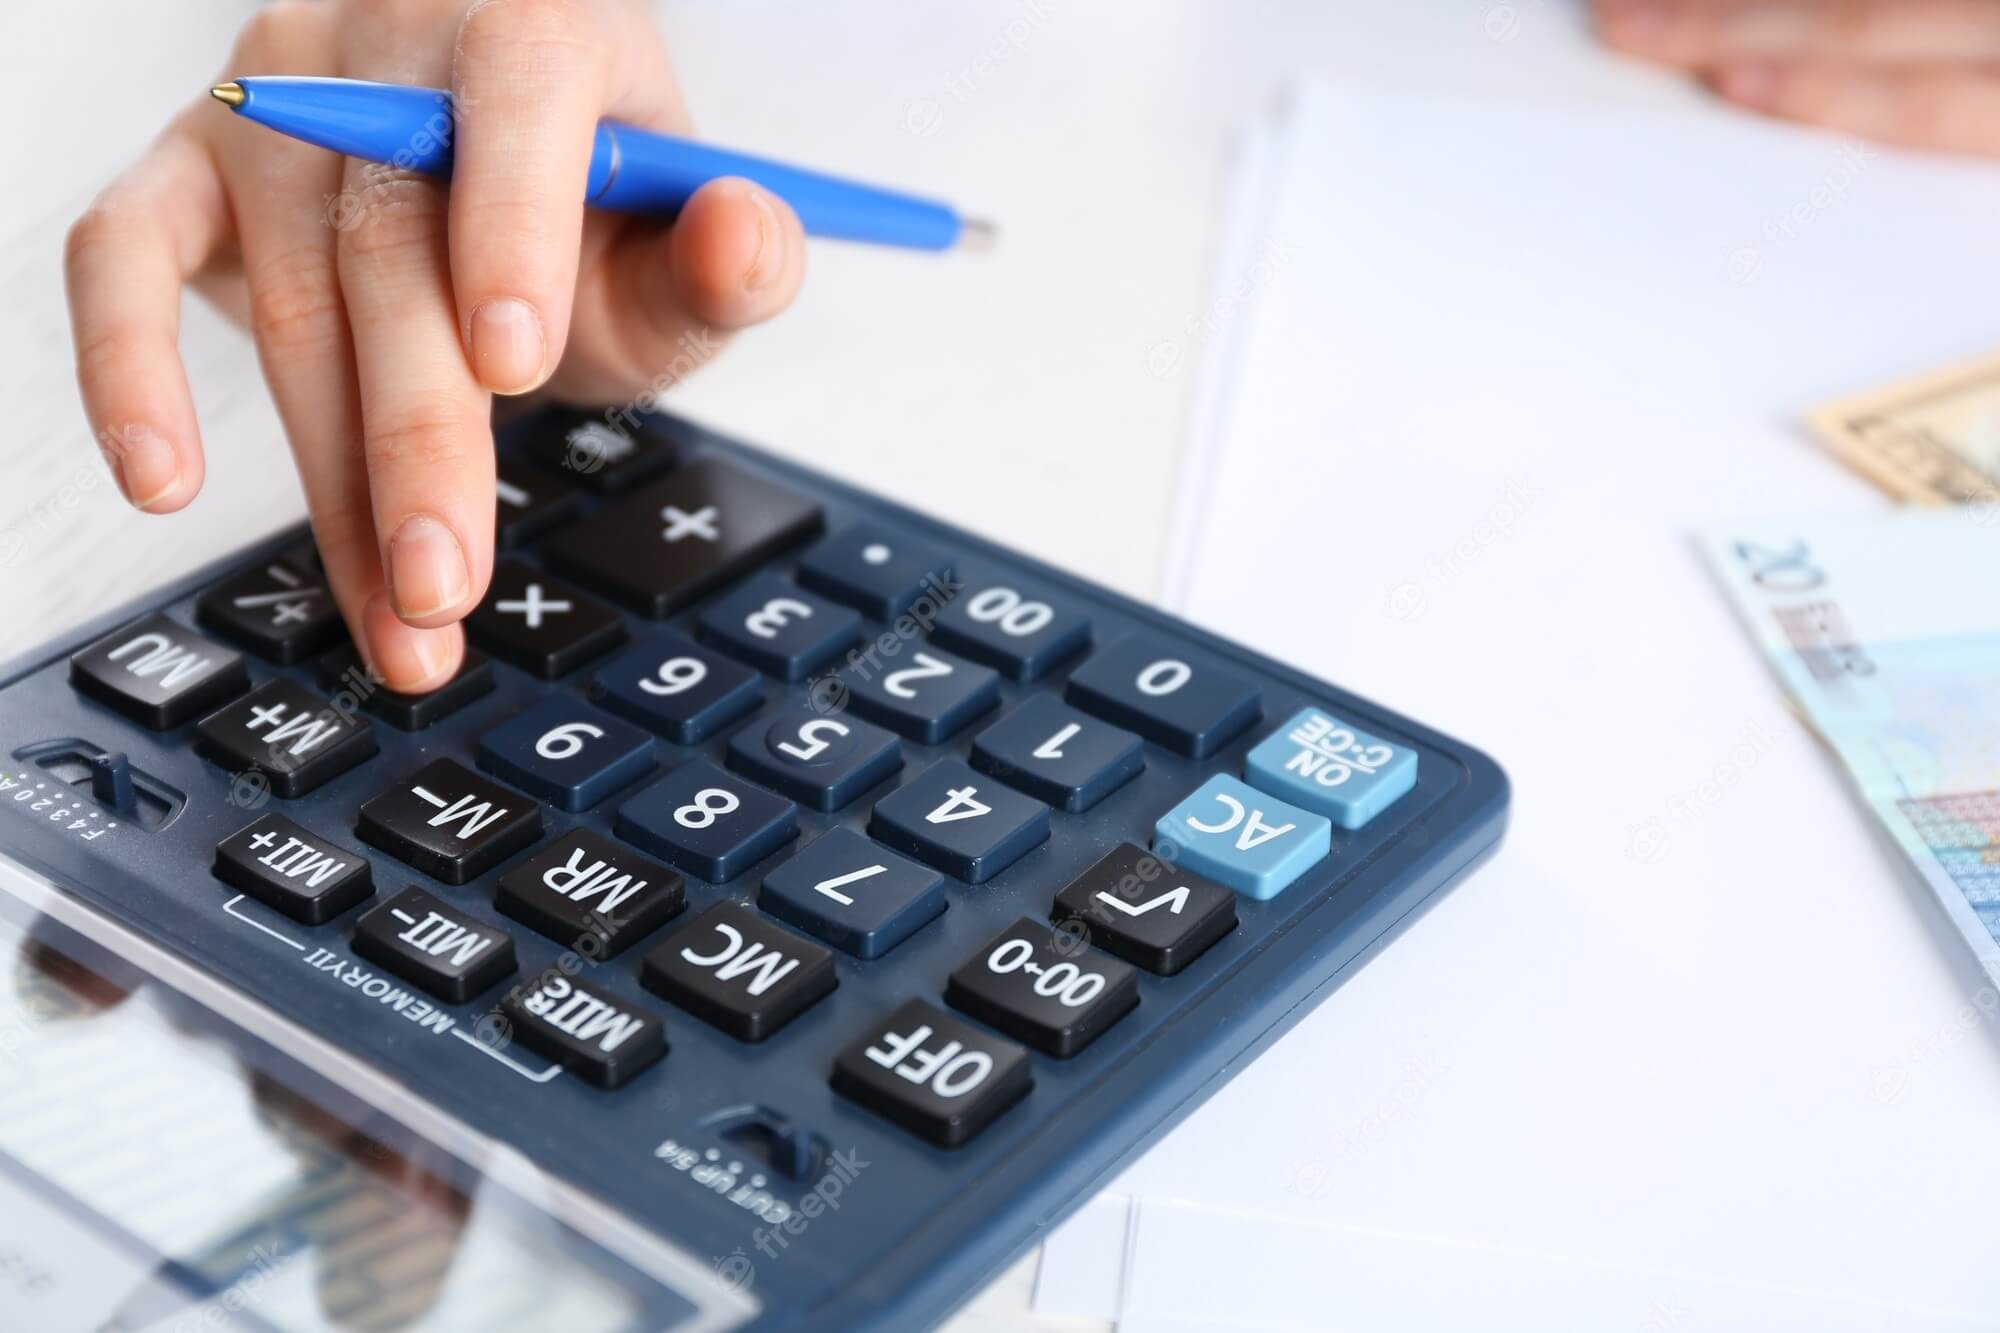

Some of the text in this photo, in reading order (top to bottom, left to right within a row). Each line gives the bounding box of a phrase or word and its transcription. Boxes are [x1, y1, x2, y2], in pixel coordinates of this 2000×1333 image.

[746, 599, 812, 638] 3
[967, 588, 1053, 635] 00
[107, 632, 210, 688] MU
[639, 658, 706, 694] 6
[884, 653, 953, 698] 2
[1136, 660, 1191, 695] 0
[246, 703, 342, 756] M+
[536, 723, 603, 759] 9
[778, 719, 849, 760] 5
[1033, 723, 1081, 758] 1
[1285, 748, 1352, 787] ON
[673, 788, 739, 828] 8
[925, 786, 992, 823] 4
[1187, 794, 1296, 850] AC
[543, 848, 647, 913] MR
[814, 865, 888, 905] 7
[681, 924, 799, 995] MC
[866, 1026, 993, 1097] OFF
